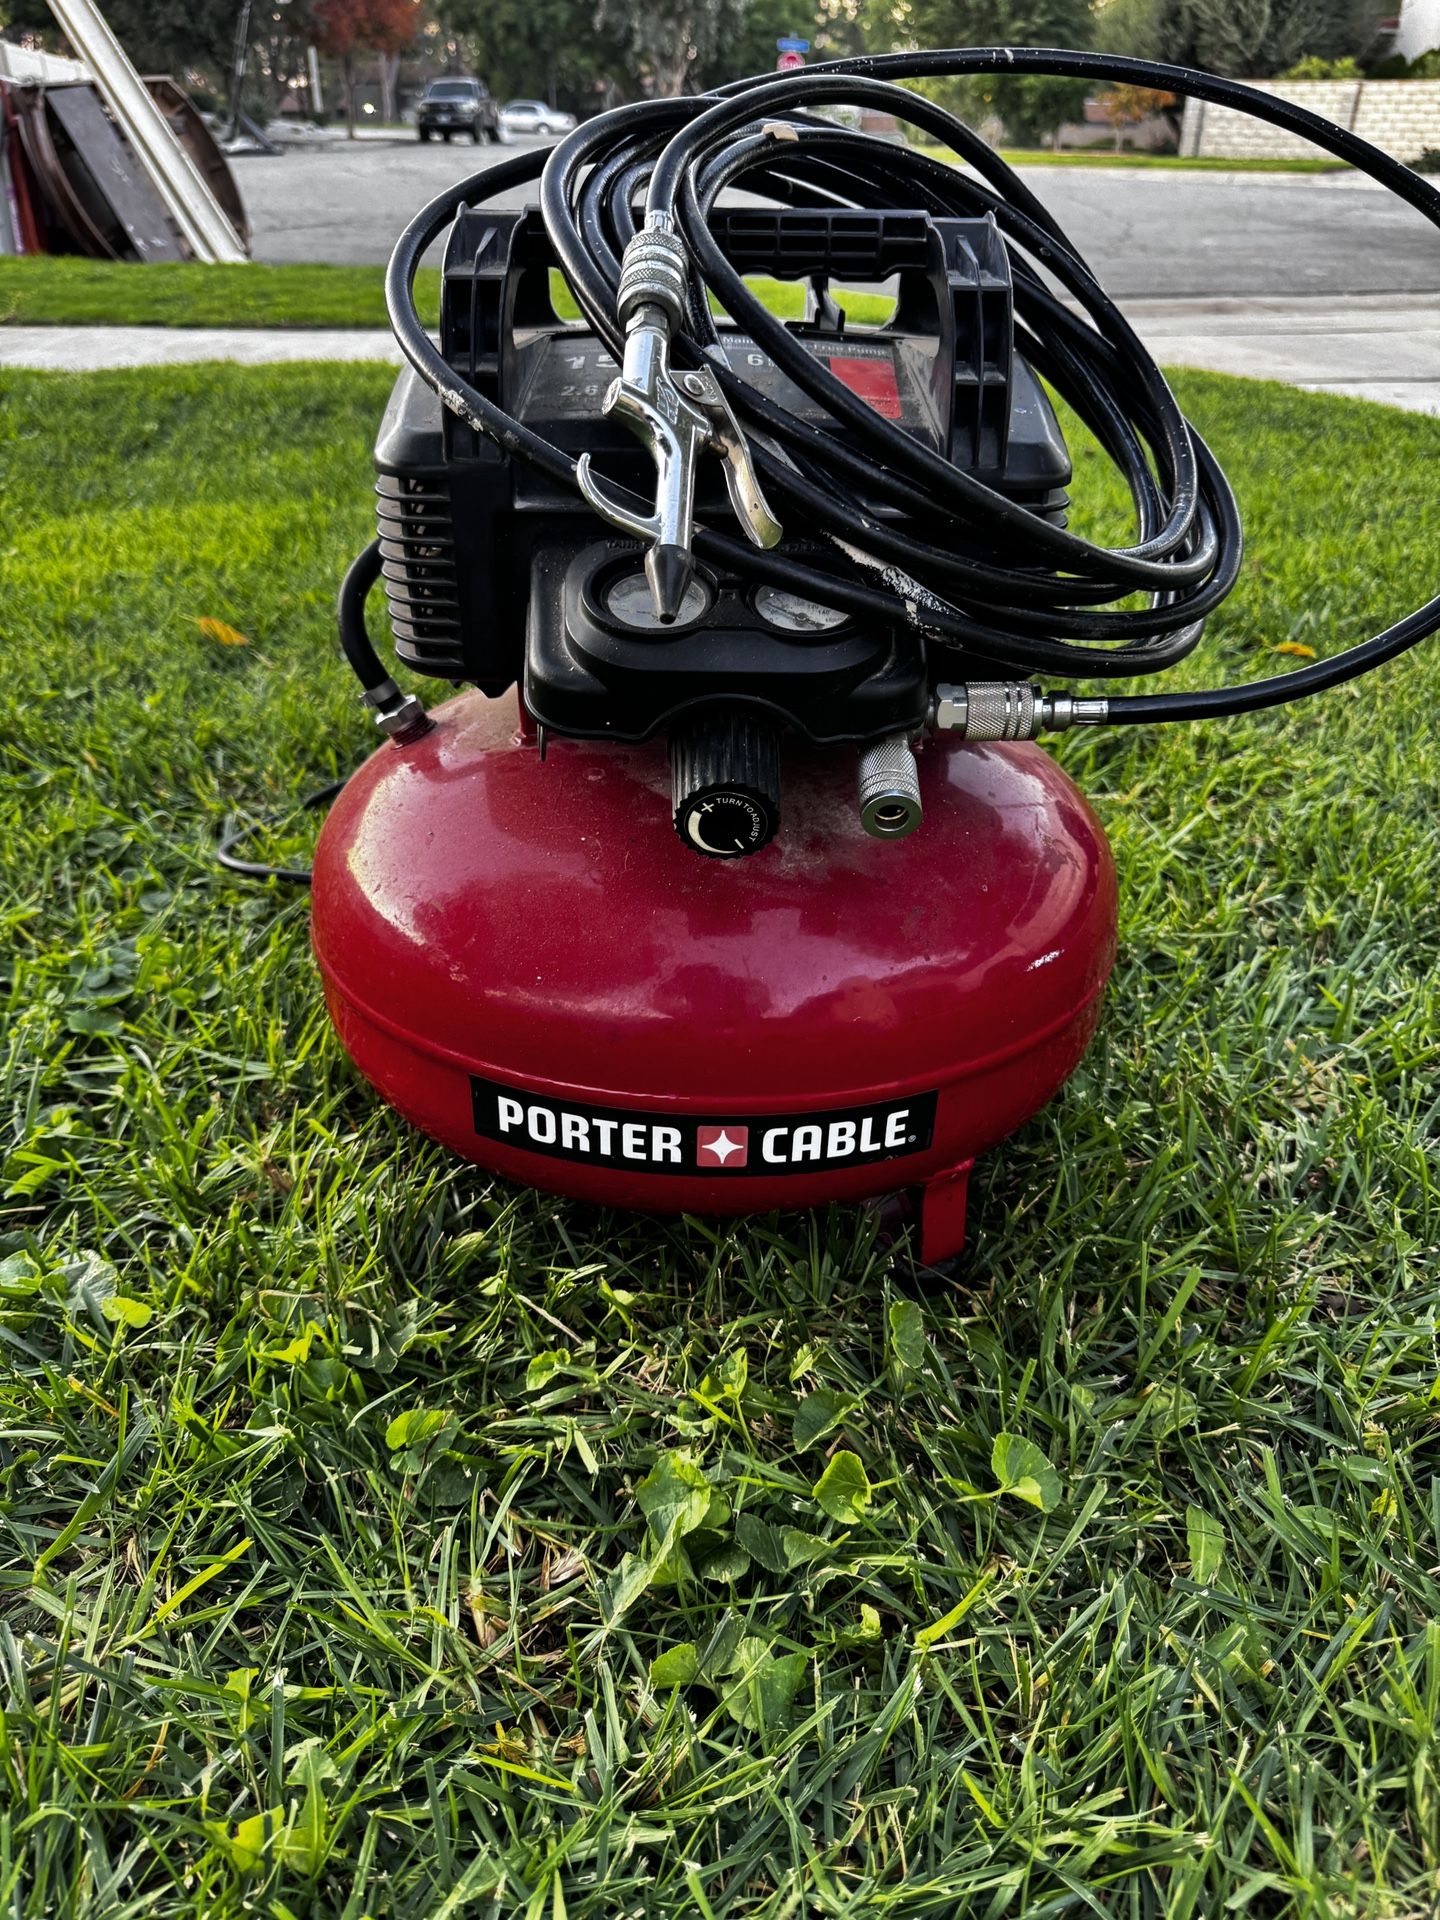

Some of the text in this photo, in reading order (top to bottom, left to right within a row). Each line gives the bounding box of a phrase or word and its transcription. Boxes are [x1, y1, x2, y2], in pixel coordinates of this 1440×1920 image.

[747, 353, 764, 366] 6
[561, 385, 599, 397] 2.6
[716, 797, 761, 843] TURN TO ADJUST
[497, 1095, 682, 1163] PORTER
